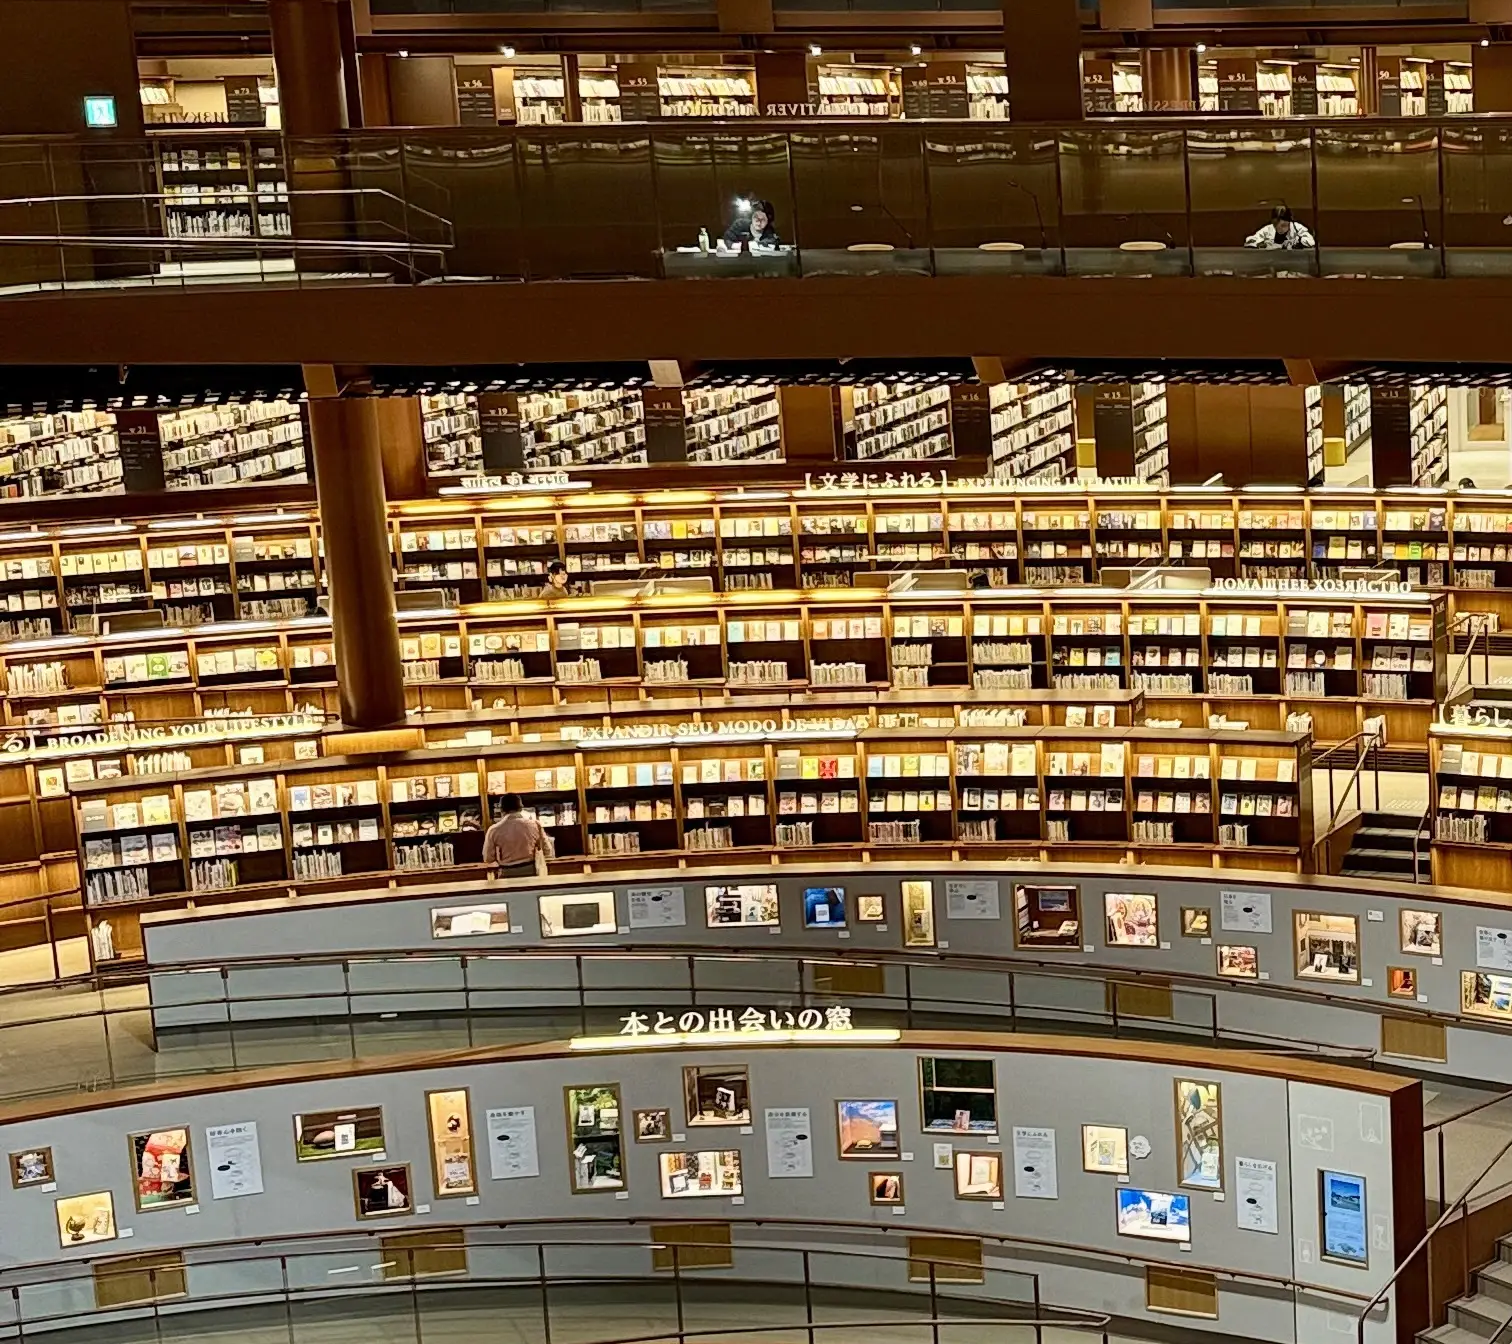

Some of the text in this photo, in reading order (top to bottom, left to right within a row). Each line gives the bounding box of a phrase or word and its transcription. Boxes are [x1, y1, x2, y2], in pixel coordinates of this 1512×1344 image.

[958, 478, 1061, 487] EXPERIENCING
[1065, 476, 1147, 487] LITERATURE
[47, 725, 167, 750] BROADENING
[169, 720, 219, 737] YOUR
[678, 720, 712, 735] SEU
[718, 718, 777, 734] MODO
[618, 1005, 854, 1037] 本との出会いの窓
